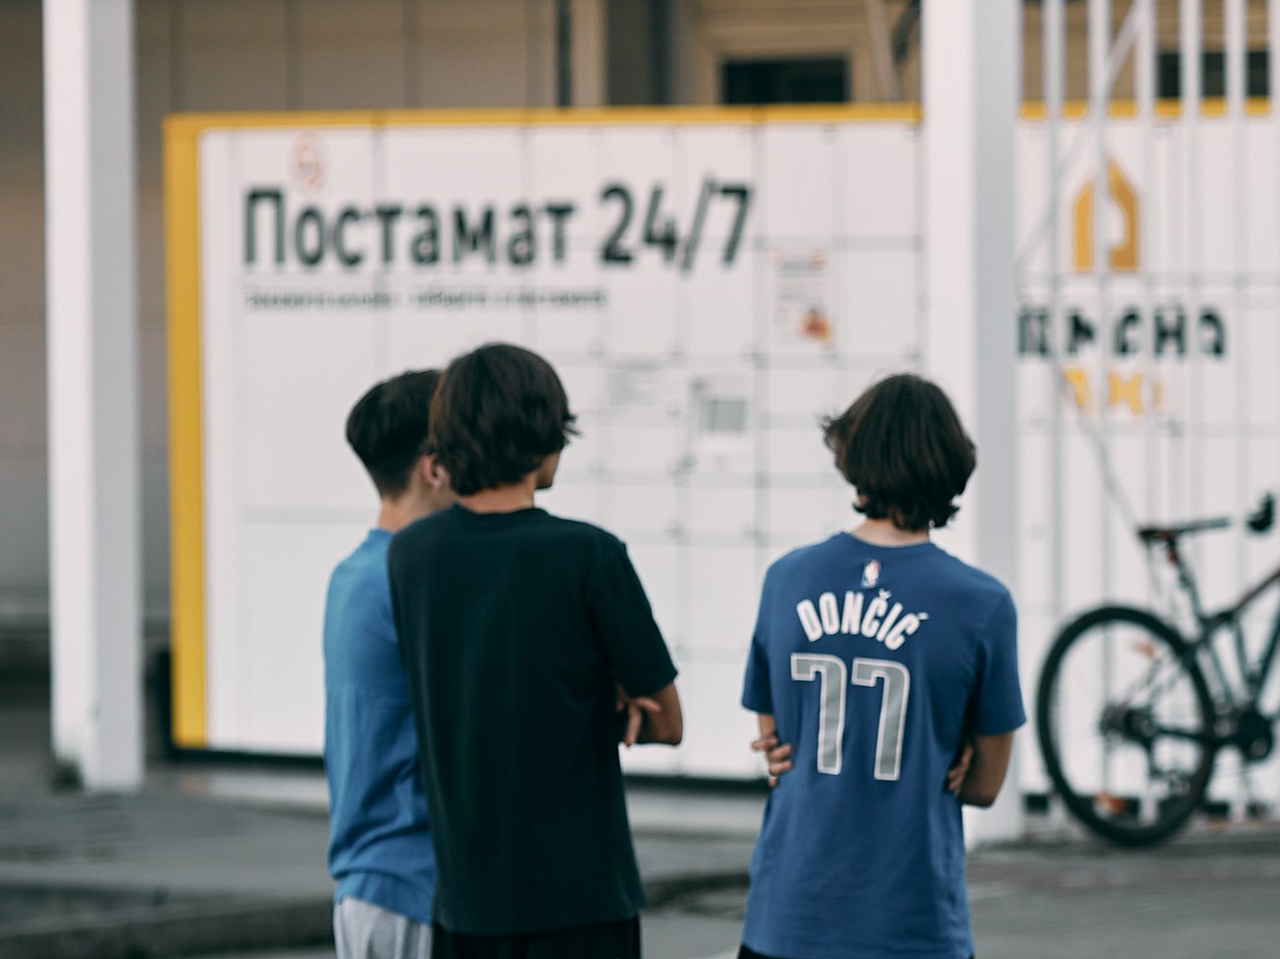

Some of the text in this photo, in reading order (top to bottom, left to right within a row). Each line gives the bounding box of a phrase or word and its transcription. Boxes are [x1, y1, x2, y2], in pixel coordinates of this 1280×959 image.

[245, 175, 755, 275] Постамат 24/7
[796, 588, 929, 650] DONČIĆ
[790, 652, 911, 782] 77
